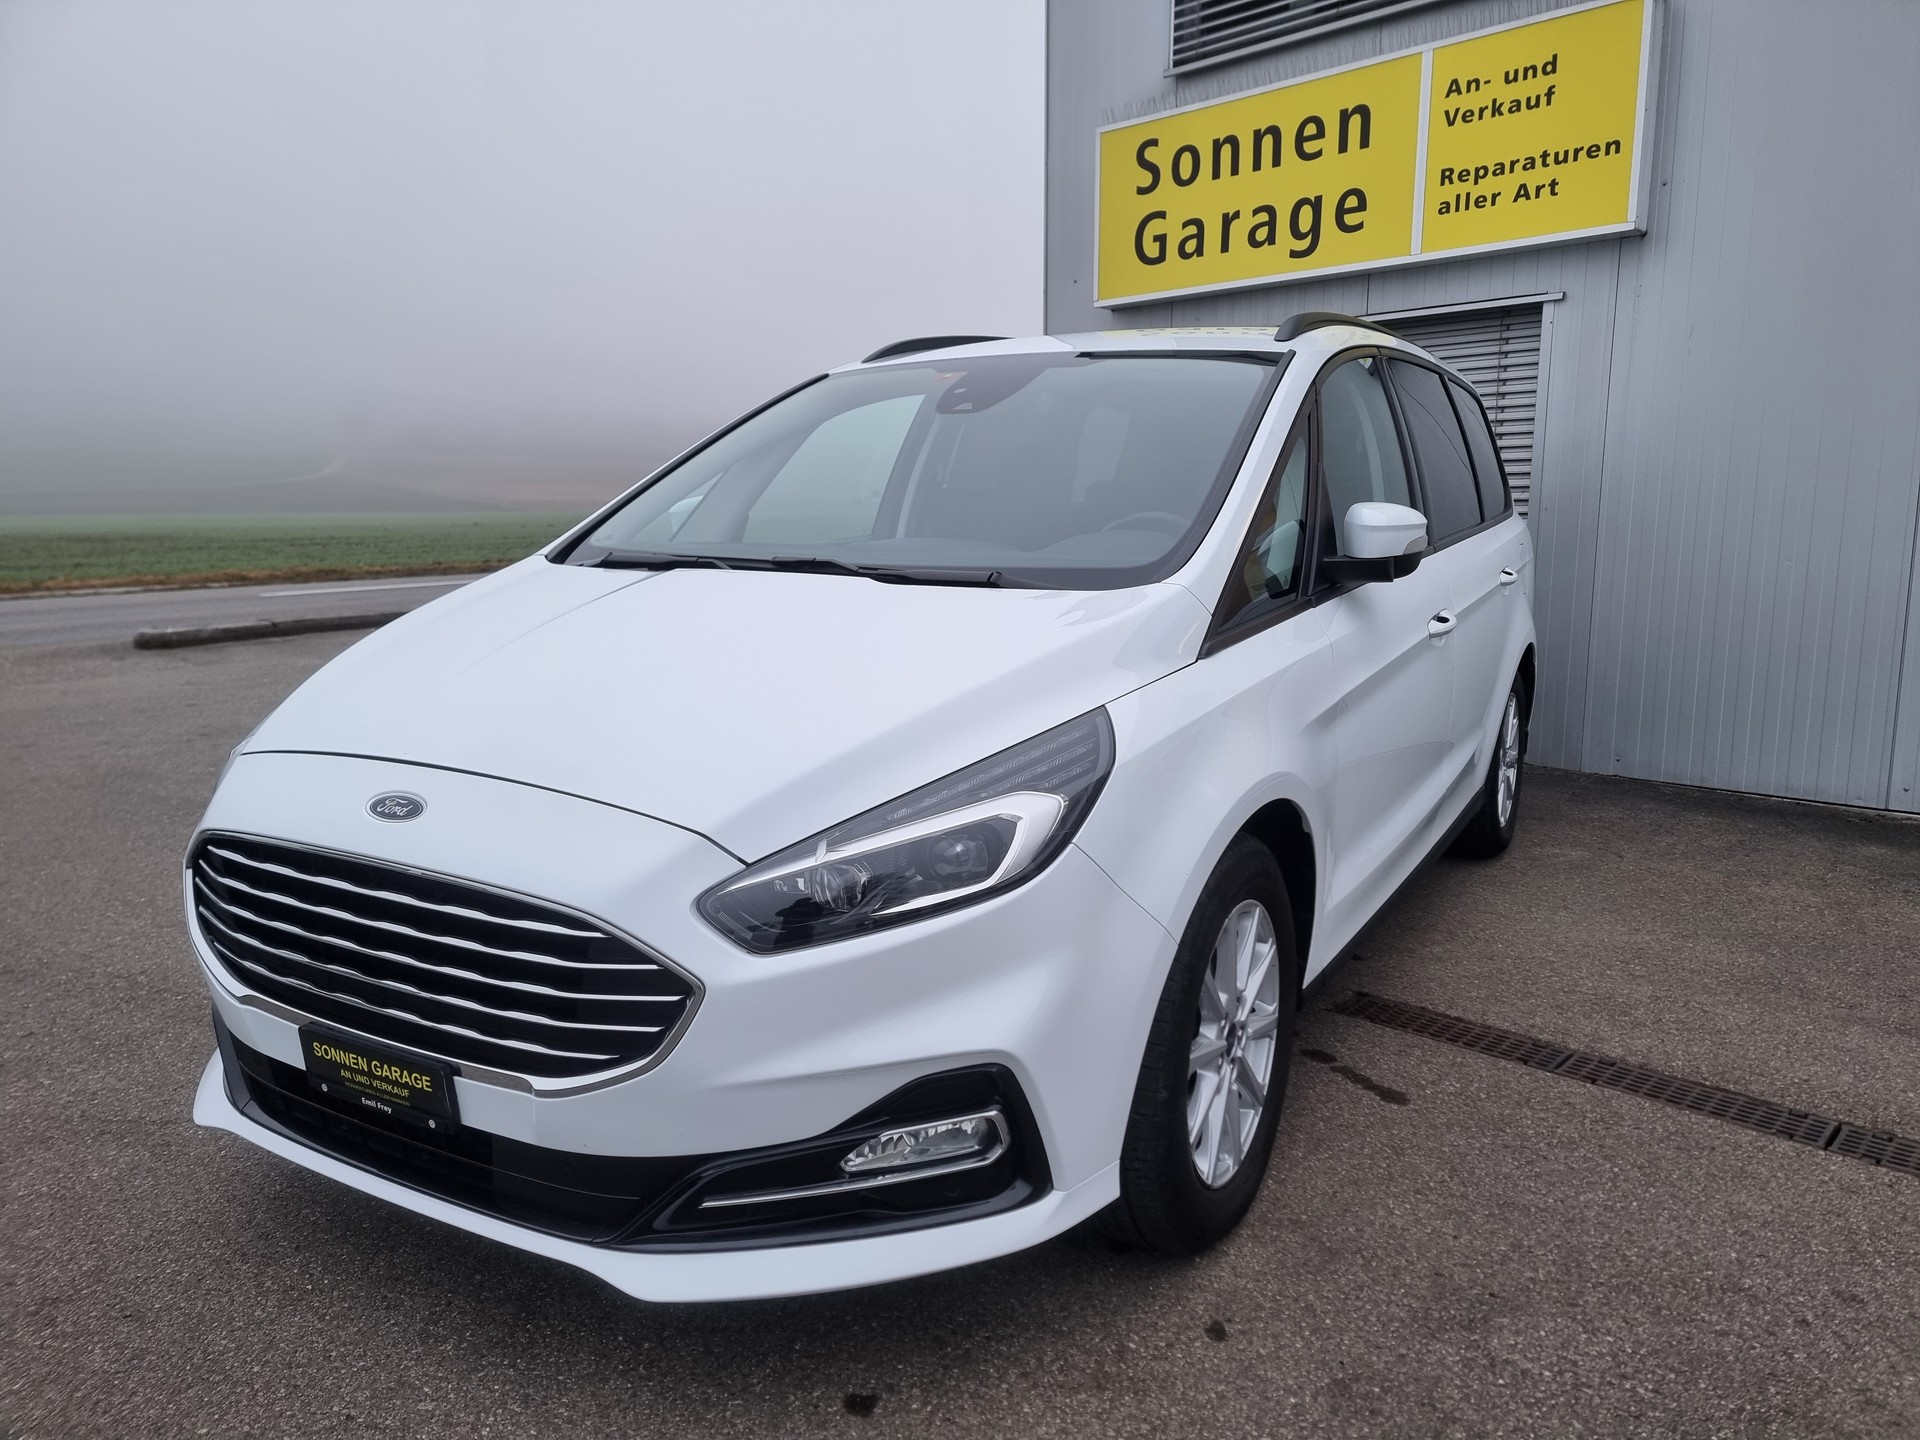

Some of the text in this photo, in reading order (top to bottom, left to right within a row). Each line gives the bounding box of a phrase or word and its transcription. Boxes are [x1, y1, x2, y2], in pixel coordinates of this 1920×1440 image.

[1444, 53, 1558, 99] An- und
[1443, 84, 1557, 128] Verkauf
[1135, 103, 1372, 196] Sonnen
[1439, 138, 1622, 188] Reparaturen
[1437, 177, 1560, 216] aller Art
[1133, 187, 1368, 266] Garage
[376, 797, 413, 816] Ford
[312, 1041, 433, 1092] SONNEN GARAGE
[340, 1068, 352, 1079] AN
[353, 1073, 370, 1085] UND
[371, 1079, 410, 1098] VERKAUF
[361, 1097, 392, 1114] Emil Frey
